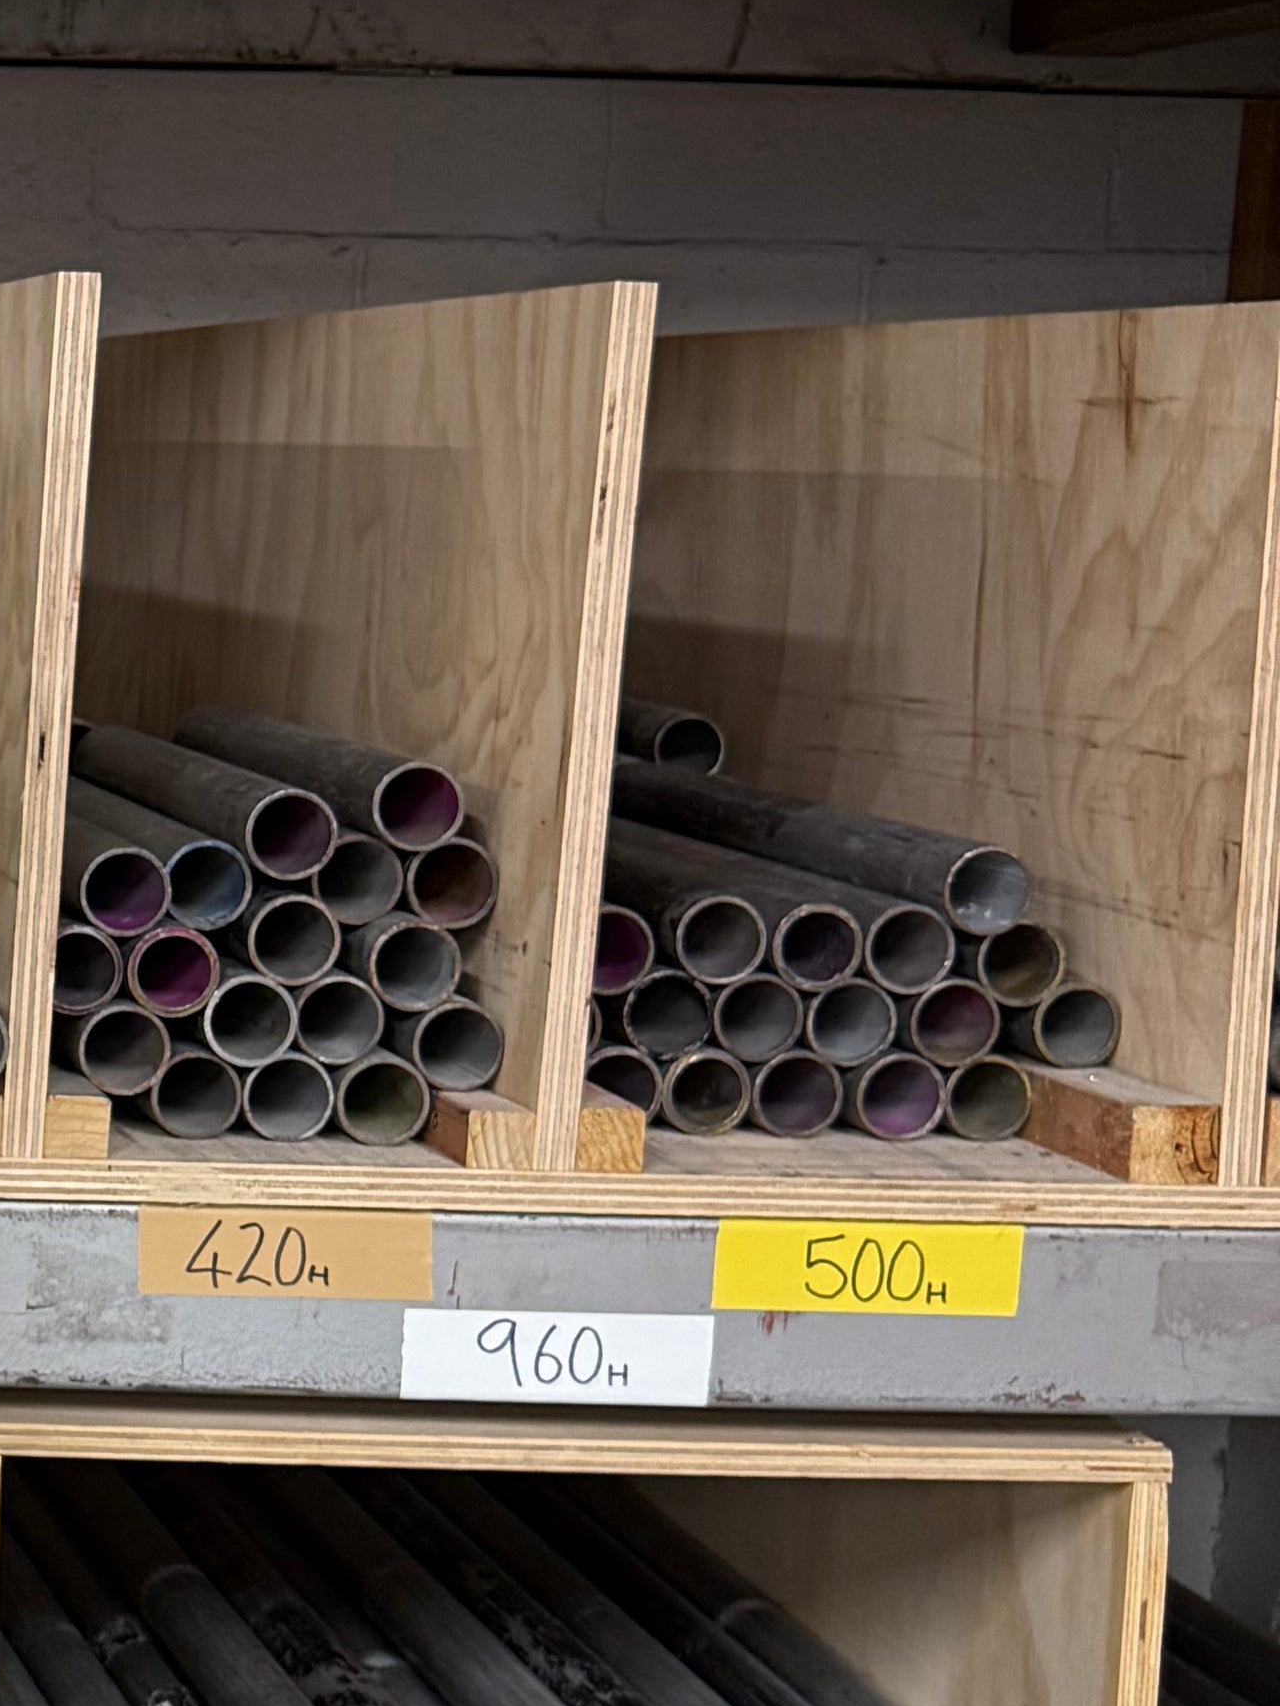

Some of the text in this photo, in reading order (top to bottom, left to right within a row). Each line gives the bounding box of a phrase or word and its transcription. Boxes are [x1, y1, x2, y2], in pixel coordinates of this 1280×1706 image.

[185, 1219, 330, 1289] 420H
[804, 1233, 947, 1305] 500H
[476, 1318, 629, 1388] 960H
